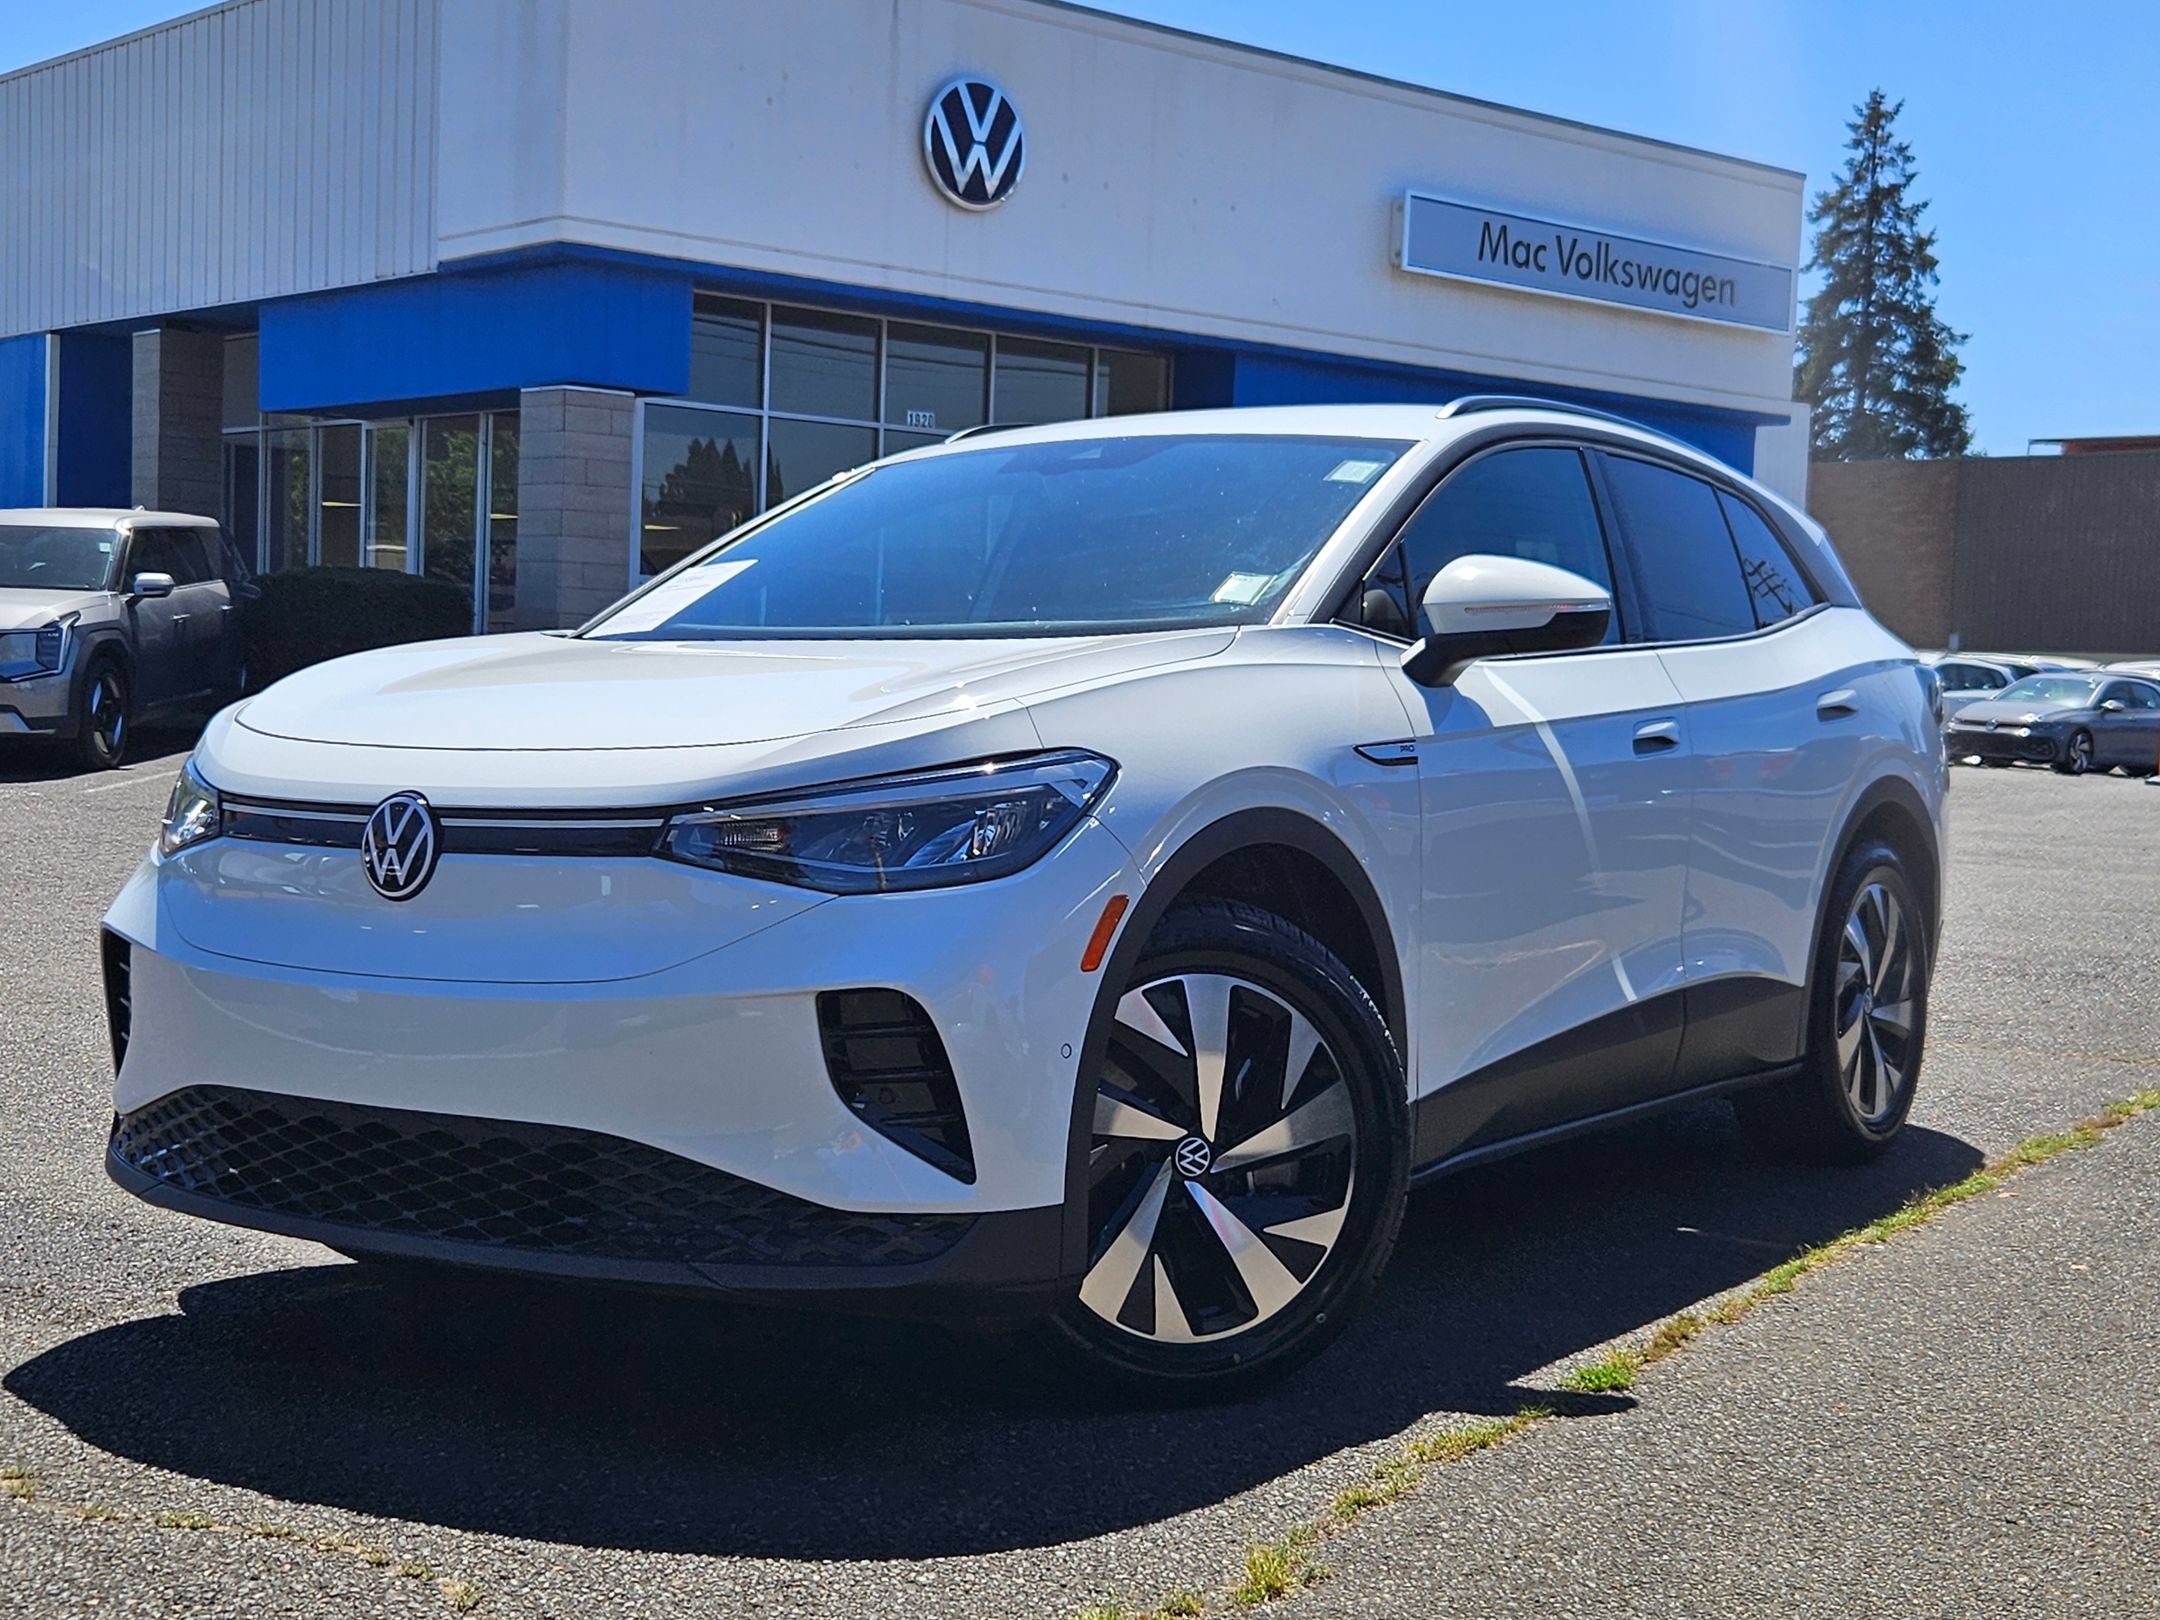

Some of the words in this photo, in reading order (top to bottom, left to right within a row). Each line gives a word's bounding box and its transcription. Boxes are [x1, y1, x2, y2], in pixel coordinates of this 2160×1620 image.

[928, 79, 1024, 205] VW
[1479, 221, 1547, 273] Mac
[1555, 234, 1736, 309] Volkswagen
[908, 412, 935, 429] 1920
[364, 799, 432, 890] VW
